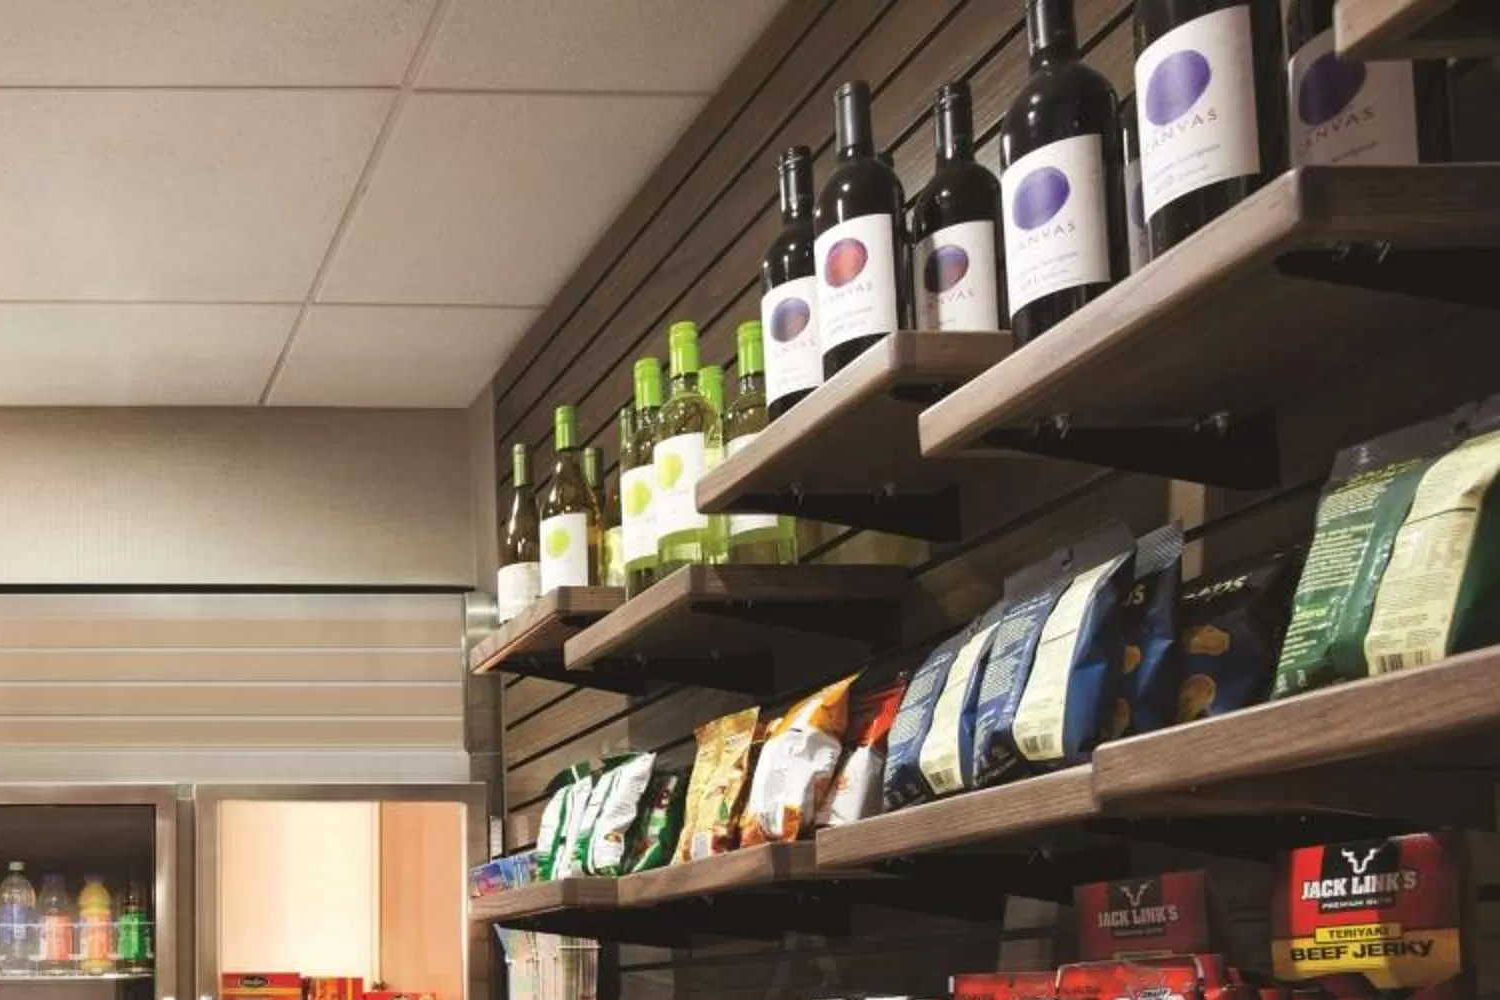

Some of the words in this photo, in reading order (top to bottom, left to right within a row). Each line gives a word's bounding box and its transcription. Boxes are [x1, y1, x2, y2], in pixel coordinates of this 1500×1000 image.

[1302, 876, 1348, 901] JACK
[1351, 869, 1418, 896] LINK'S
[1097, 909, 1129, 929] JACK
[1131, 903, 1180, 925] LINK'S
[1328, 926, 1390, 940] TERIYAKI
[1290, 944, 1348, 961] BEEF
[1351, 938, 1435, 958] JERKY
